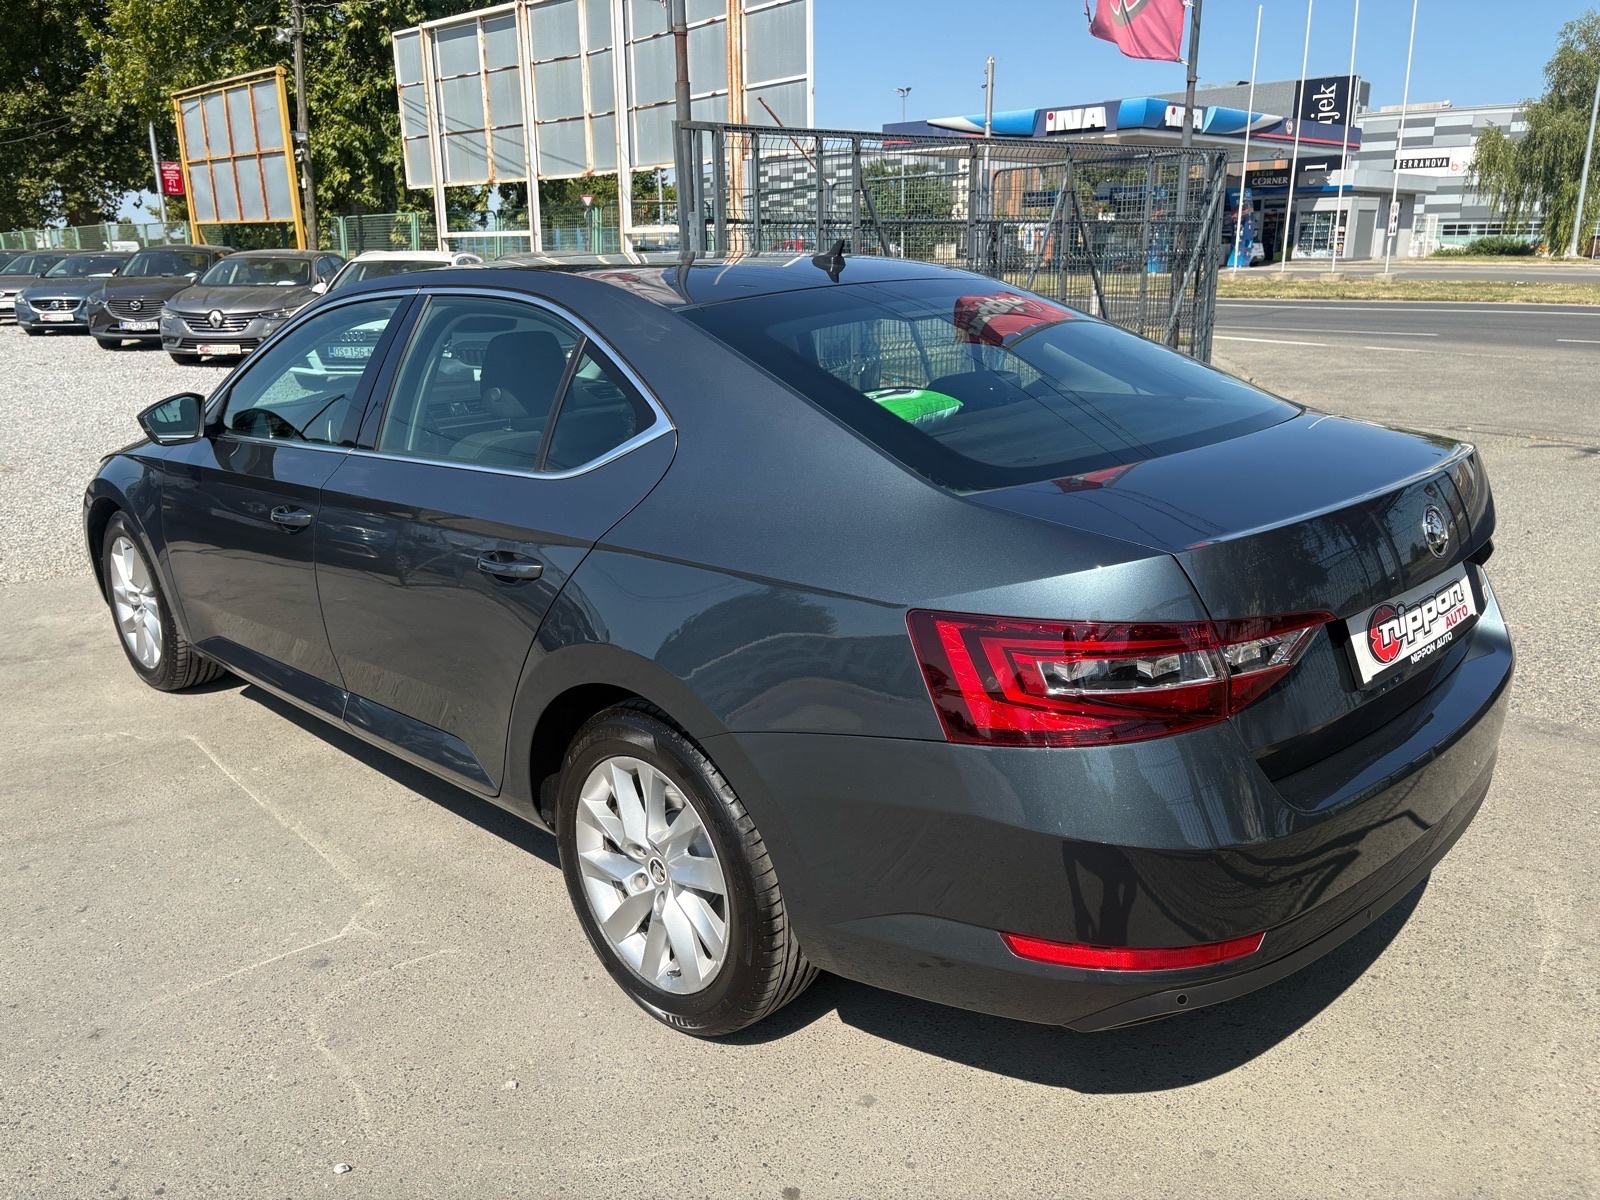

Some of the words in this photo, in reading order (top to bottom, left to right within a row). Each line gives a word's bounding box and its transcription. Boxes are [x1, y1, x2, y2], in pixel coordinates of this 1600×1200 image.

[1251, 176, 1288, 185] CORNER
[1378, 581, 1464, 645] nippon
[1445, 605, 1468, 629] AUTO
[1411, 645, 1435, 664] NIPPON
[1437, 632, 1452, 648] AUTO
